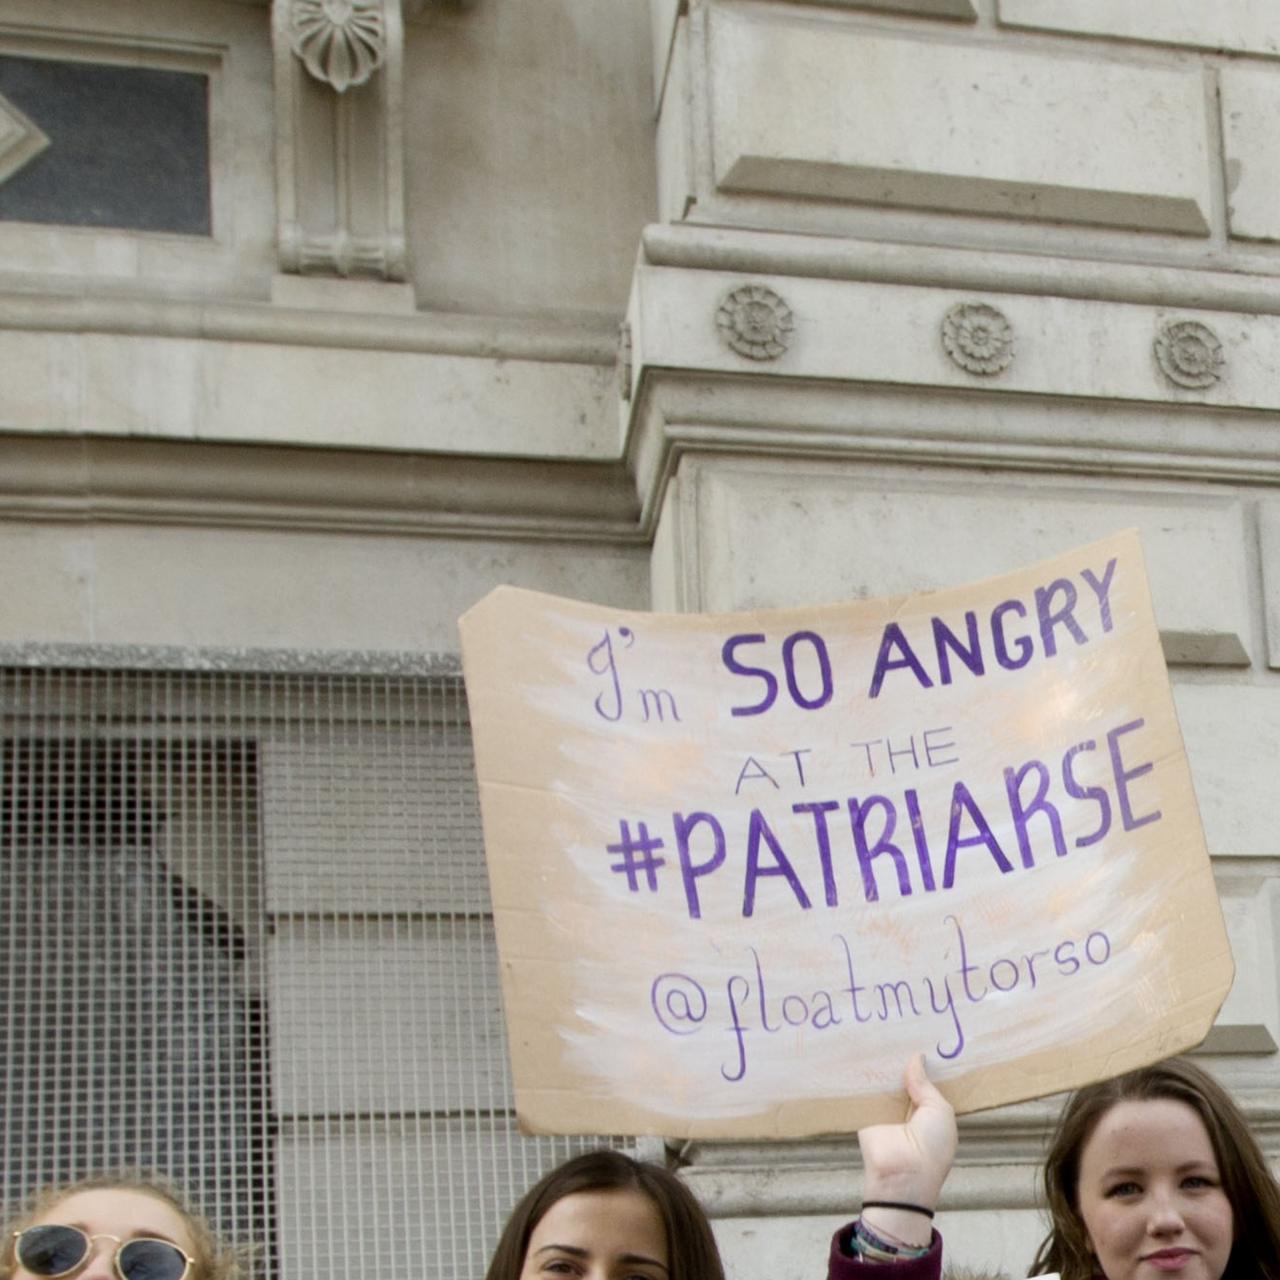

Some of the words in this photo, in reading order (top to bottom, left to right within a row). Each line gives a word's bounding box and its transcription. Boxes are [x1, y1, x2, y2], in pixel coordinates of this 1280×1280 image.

[588, 624, 683, 723] I'm
[721, 630, 834, 717] SO
[867, 557, 1118, 700] ANGRY
[606, 717, 1163, 919] #PATRIARSE
[734, 748, 813, 796] AT
[850, 726, 960, 778] THE
[651, 915, 1112, 1082] @floatmytorso
